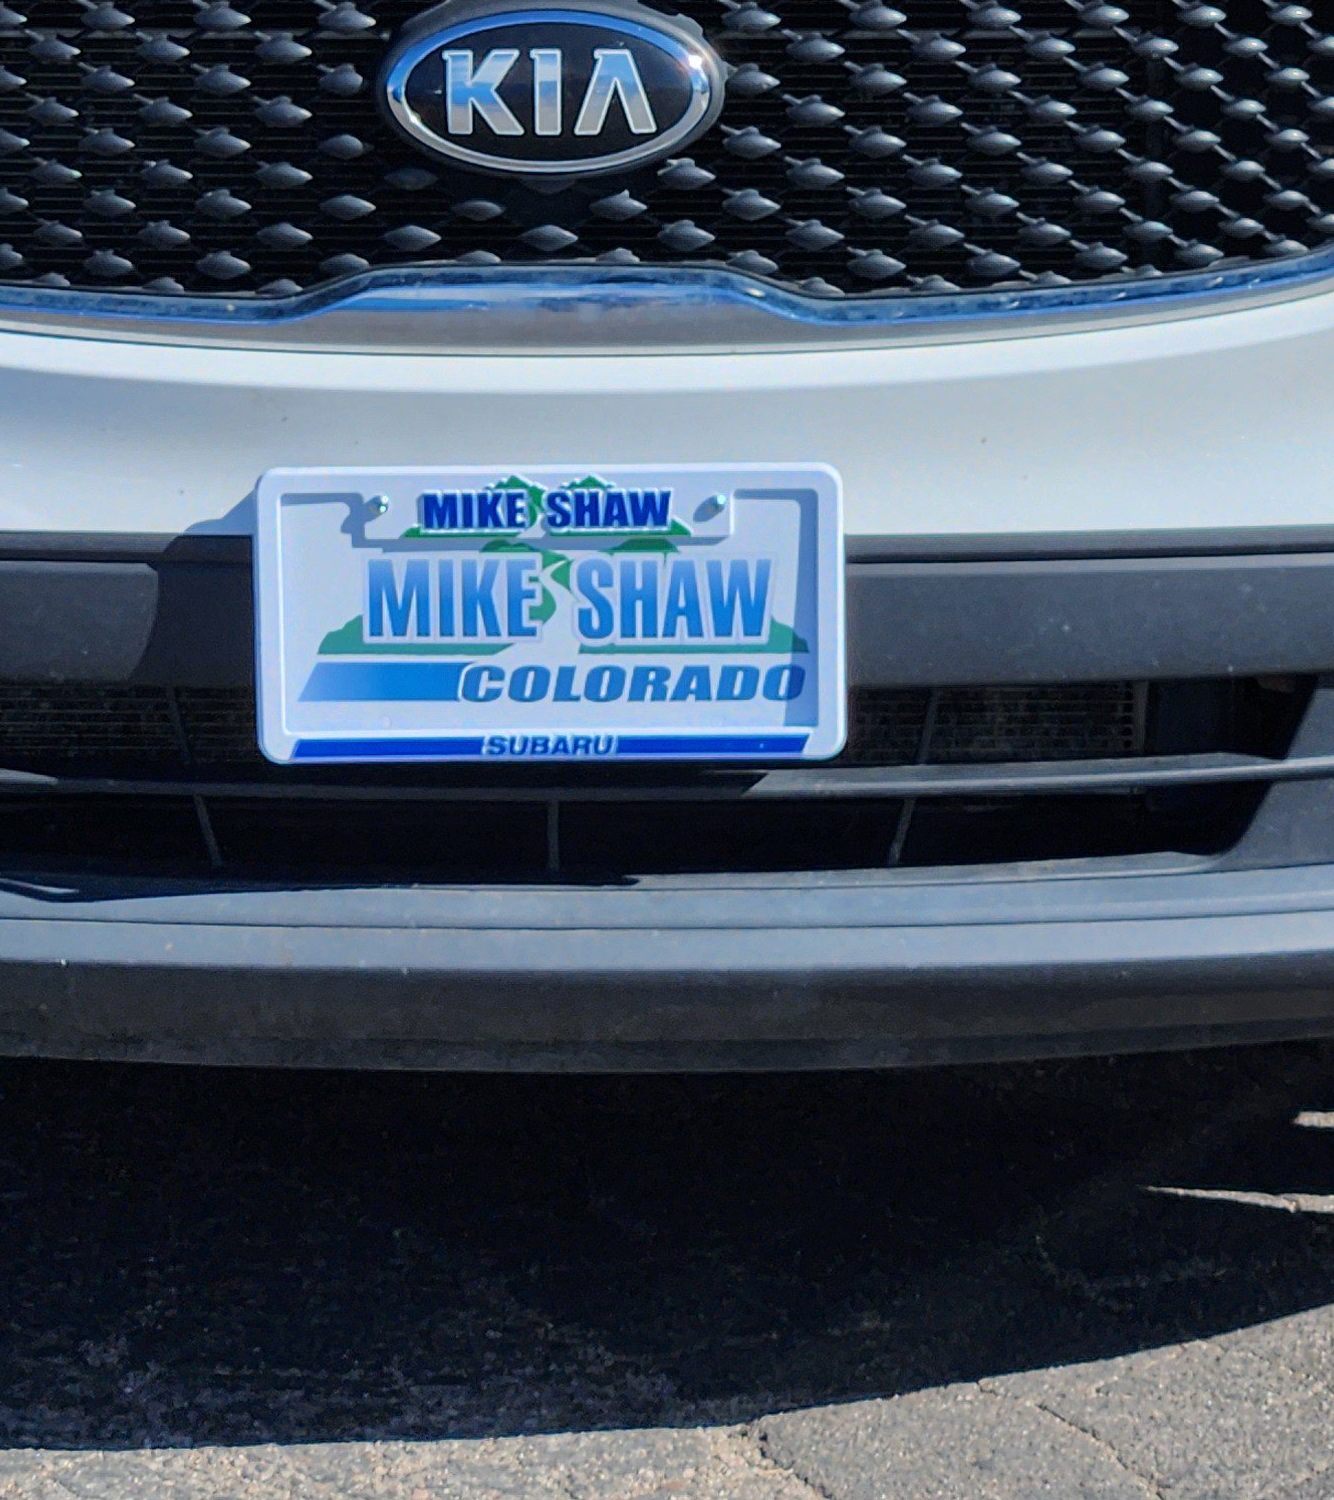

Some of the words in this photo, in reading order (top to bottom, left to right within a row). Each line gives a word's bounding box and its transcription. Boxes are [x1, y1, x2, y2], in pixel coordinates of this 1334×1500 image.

[441, 47, 658, 138] KIA
[423, 490, 527, 529] MIKE
[546, 488, 672, 529] SHAW
[368, 557, 539, 638] MIKE
[577, 556, 772, 639] SHAW
[461, 664, 807, 702] COLORADO
[484, 735, 616, 757] SUBARU
